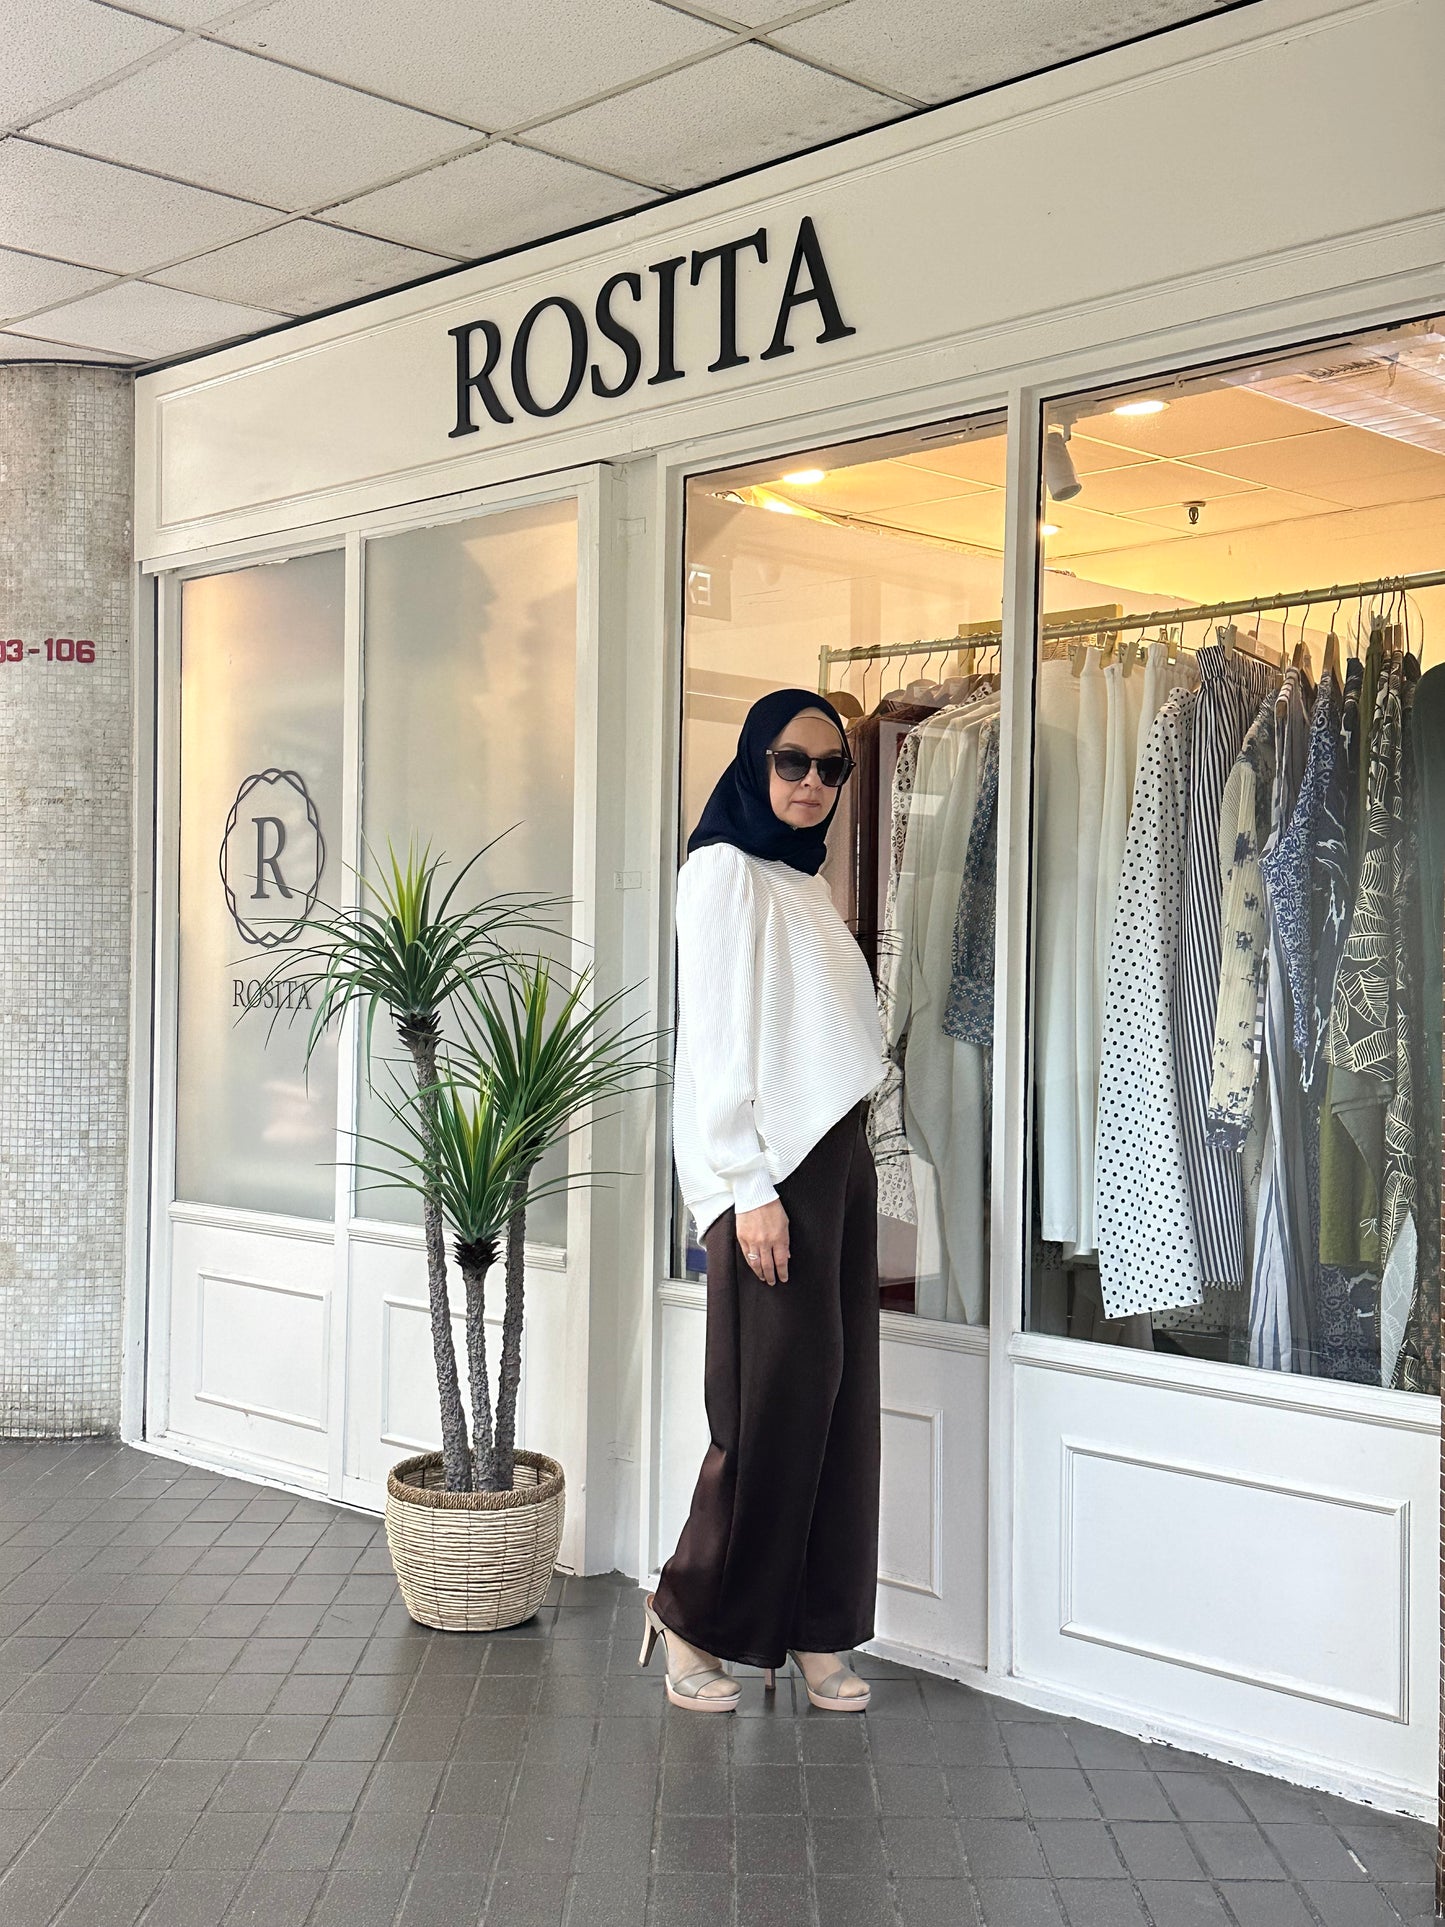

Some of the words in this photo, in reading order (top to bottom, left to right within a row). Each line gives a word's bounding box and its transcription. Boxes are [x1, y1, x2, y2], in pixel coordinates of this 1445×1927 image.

[447, 216, 857, 438] ROSITA
[250, 816, 294, 899] R
[232, 979, 312, 1010] ROSITA
